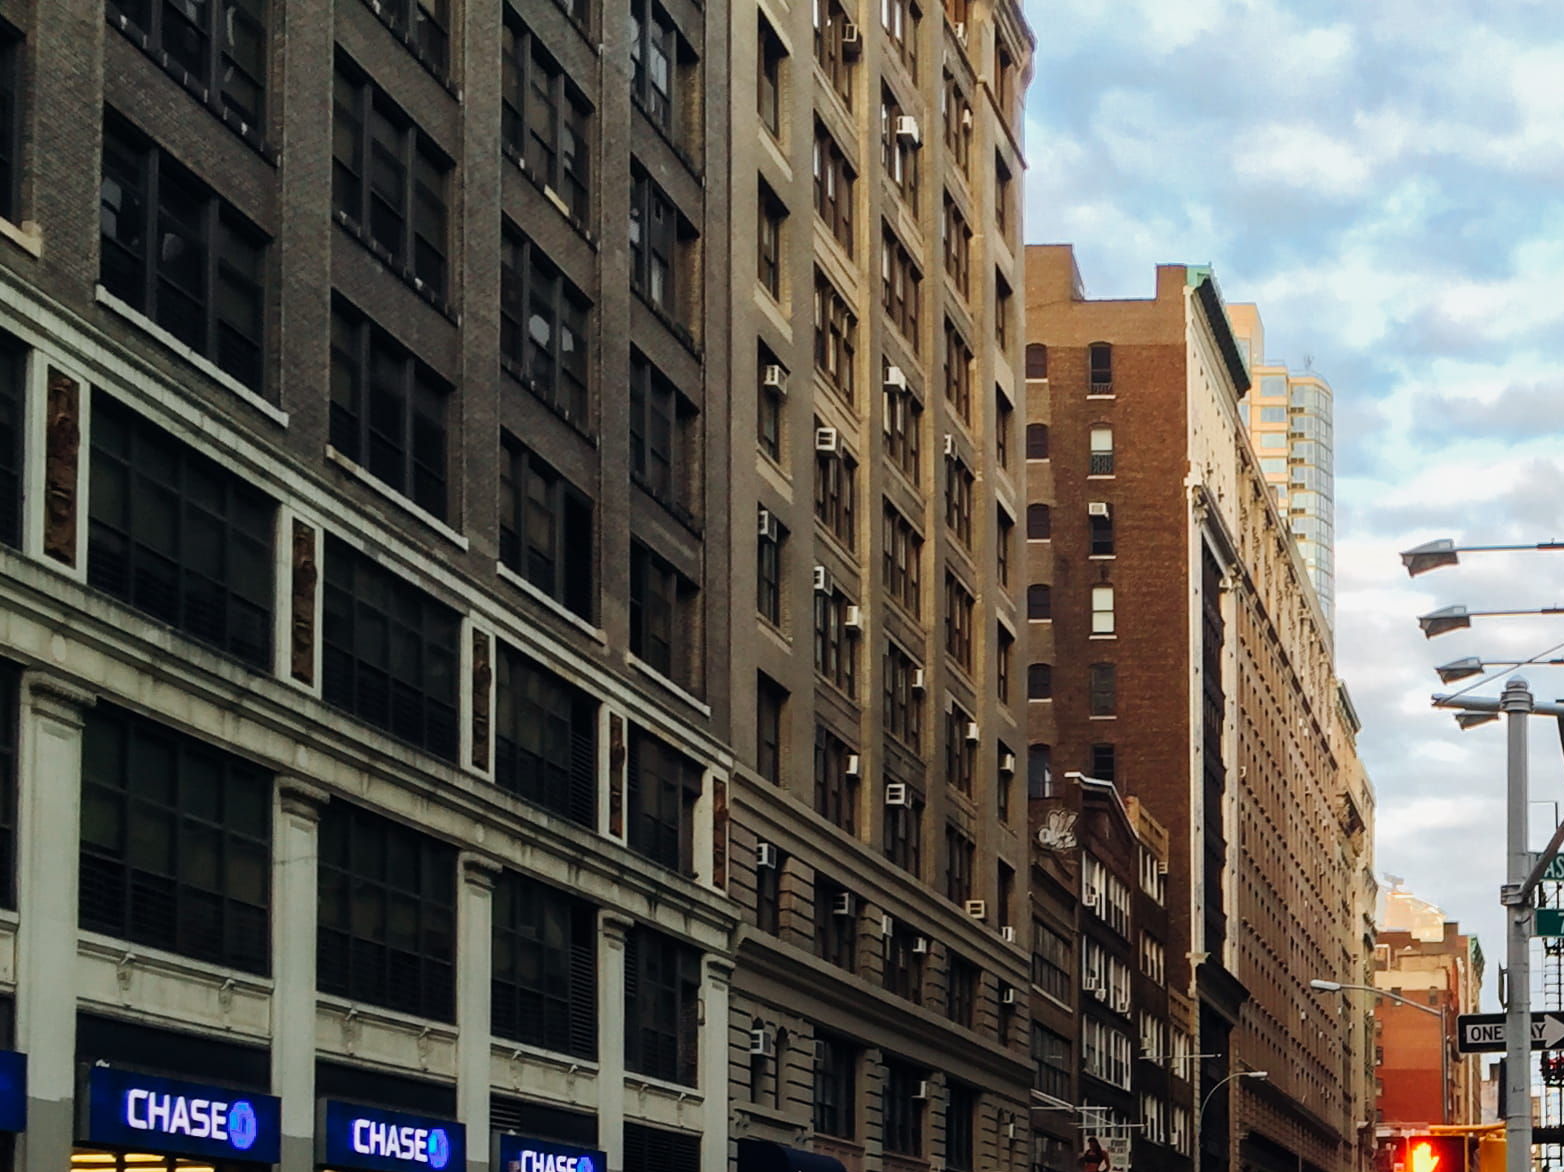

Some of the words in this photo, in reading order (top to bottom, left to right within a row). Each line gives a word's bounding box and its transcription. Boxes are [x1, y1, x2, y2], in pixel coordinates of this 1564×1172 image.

[1470, 1025, 1504, 1041] ONE
[126, 1088, 228, 1141] CHASE
[353, 1118, 429, 1163] CHASE
